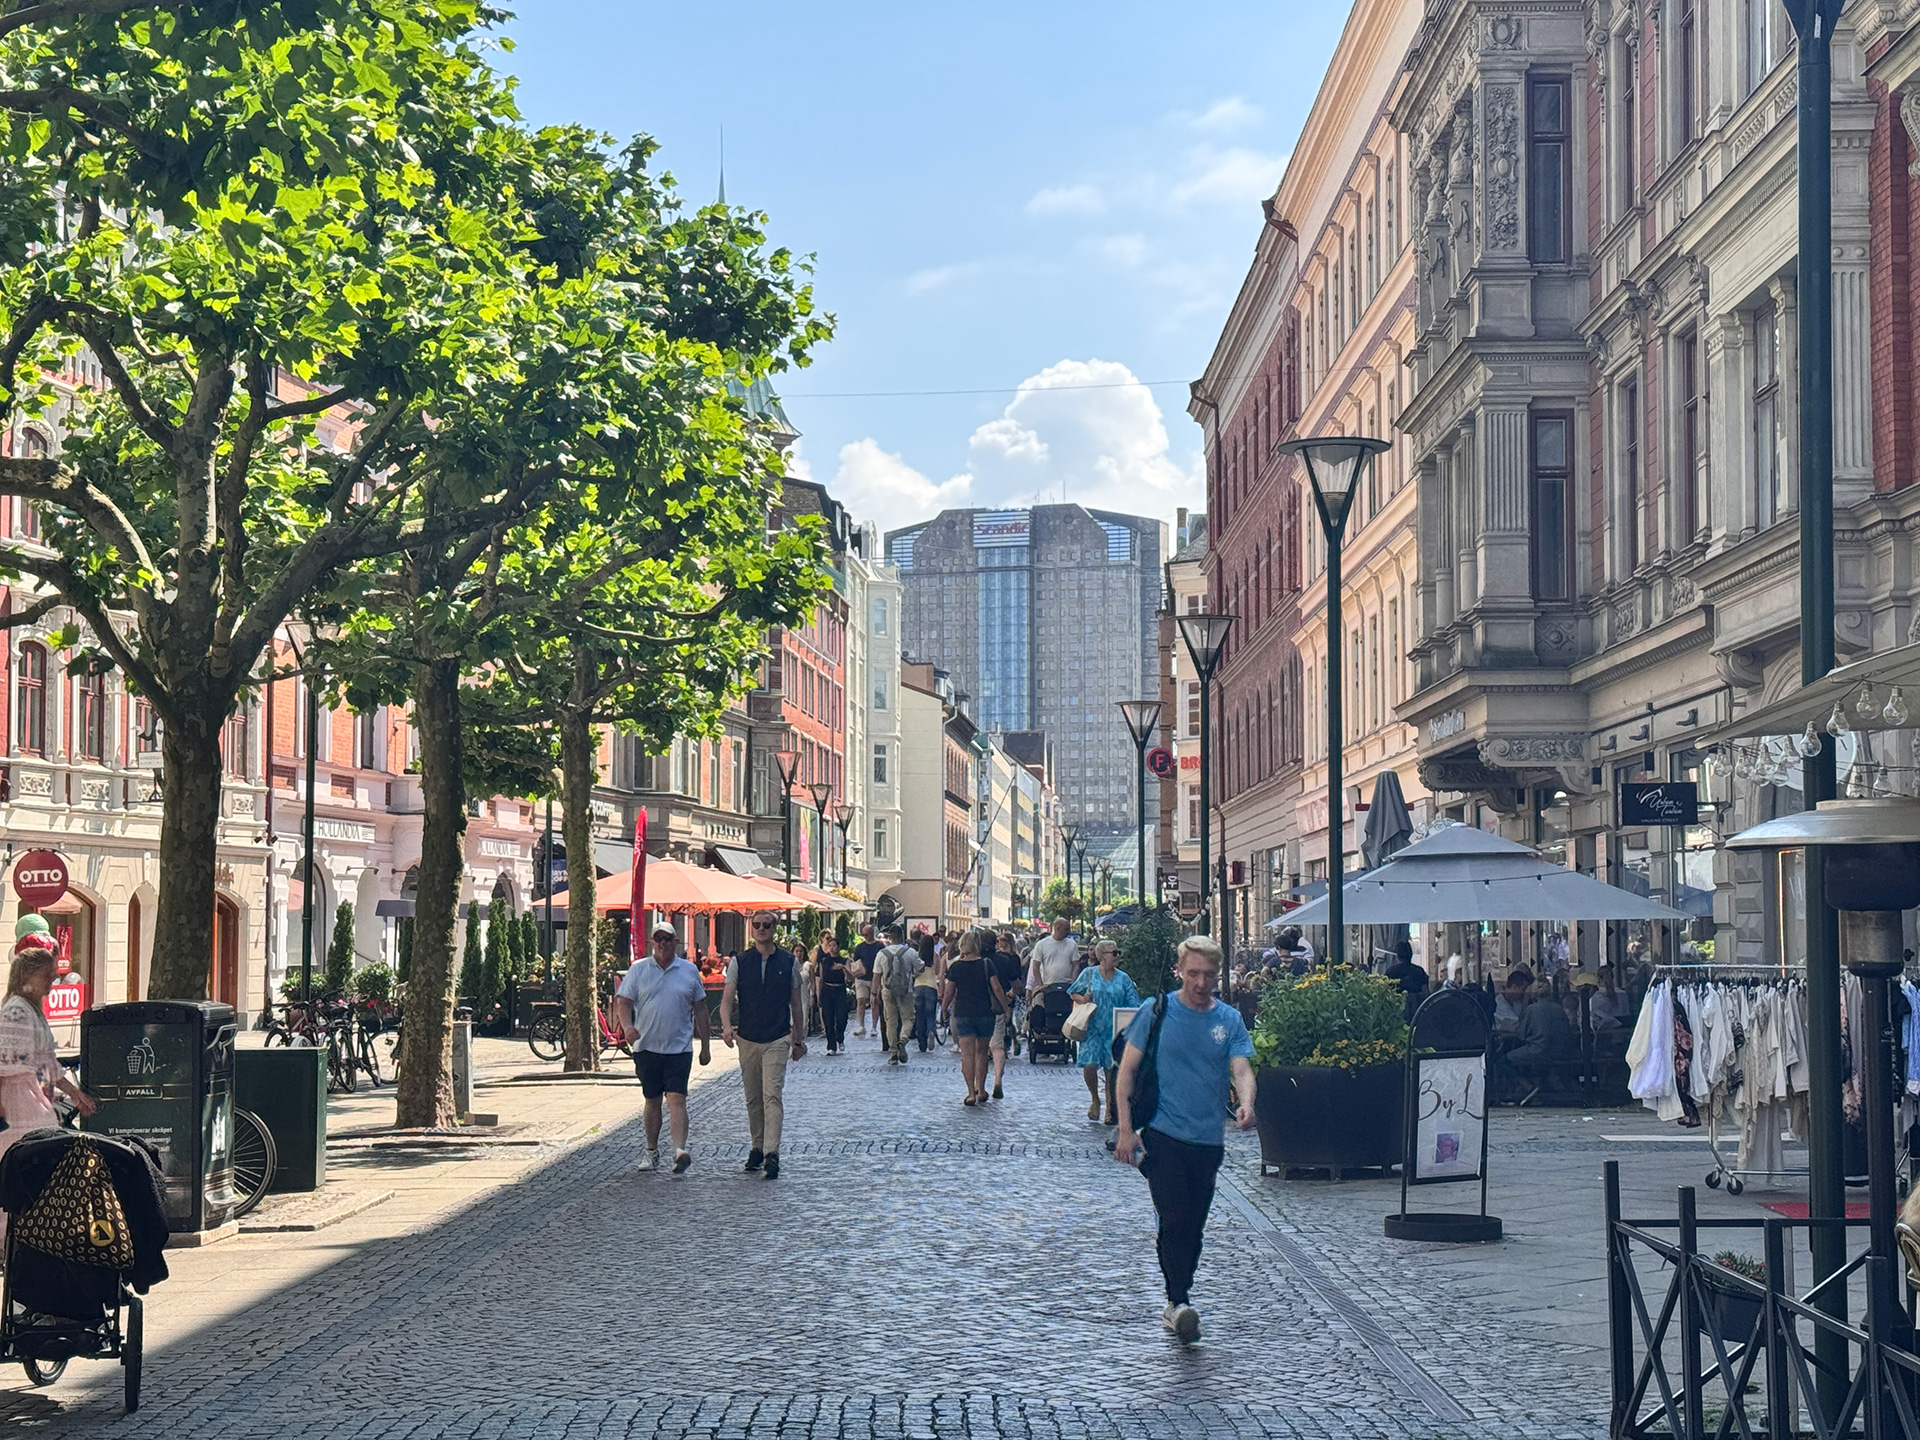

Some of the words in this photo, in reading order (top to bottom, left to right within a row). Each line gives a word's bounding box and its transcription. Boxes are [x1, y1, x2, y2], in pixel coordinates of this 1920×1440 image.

[1156, 754, 1164, 768] F
[1180, 756, 1201, 769] BR
[19, 868, 63, 884] OTTO
[48, 988, 80, 1009] OTTO
[1418, 1079, 1456, 1121] By
